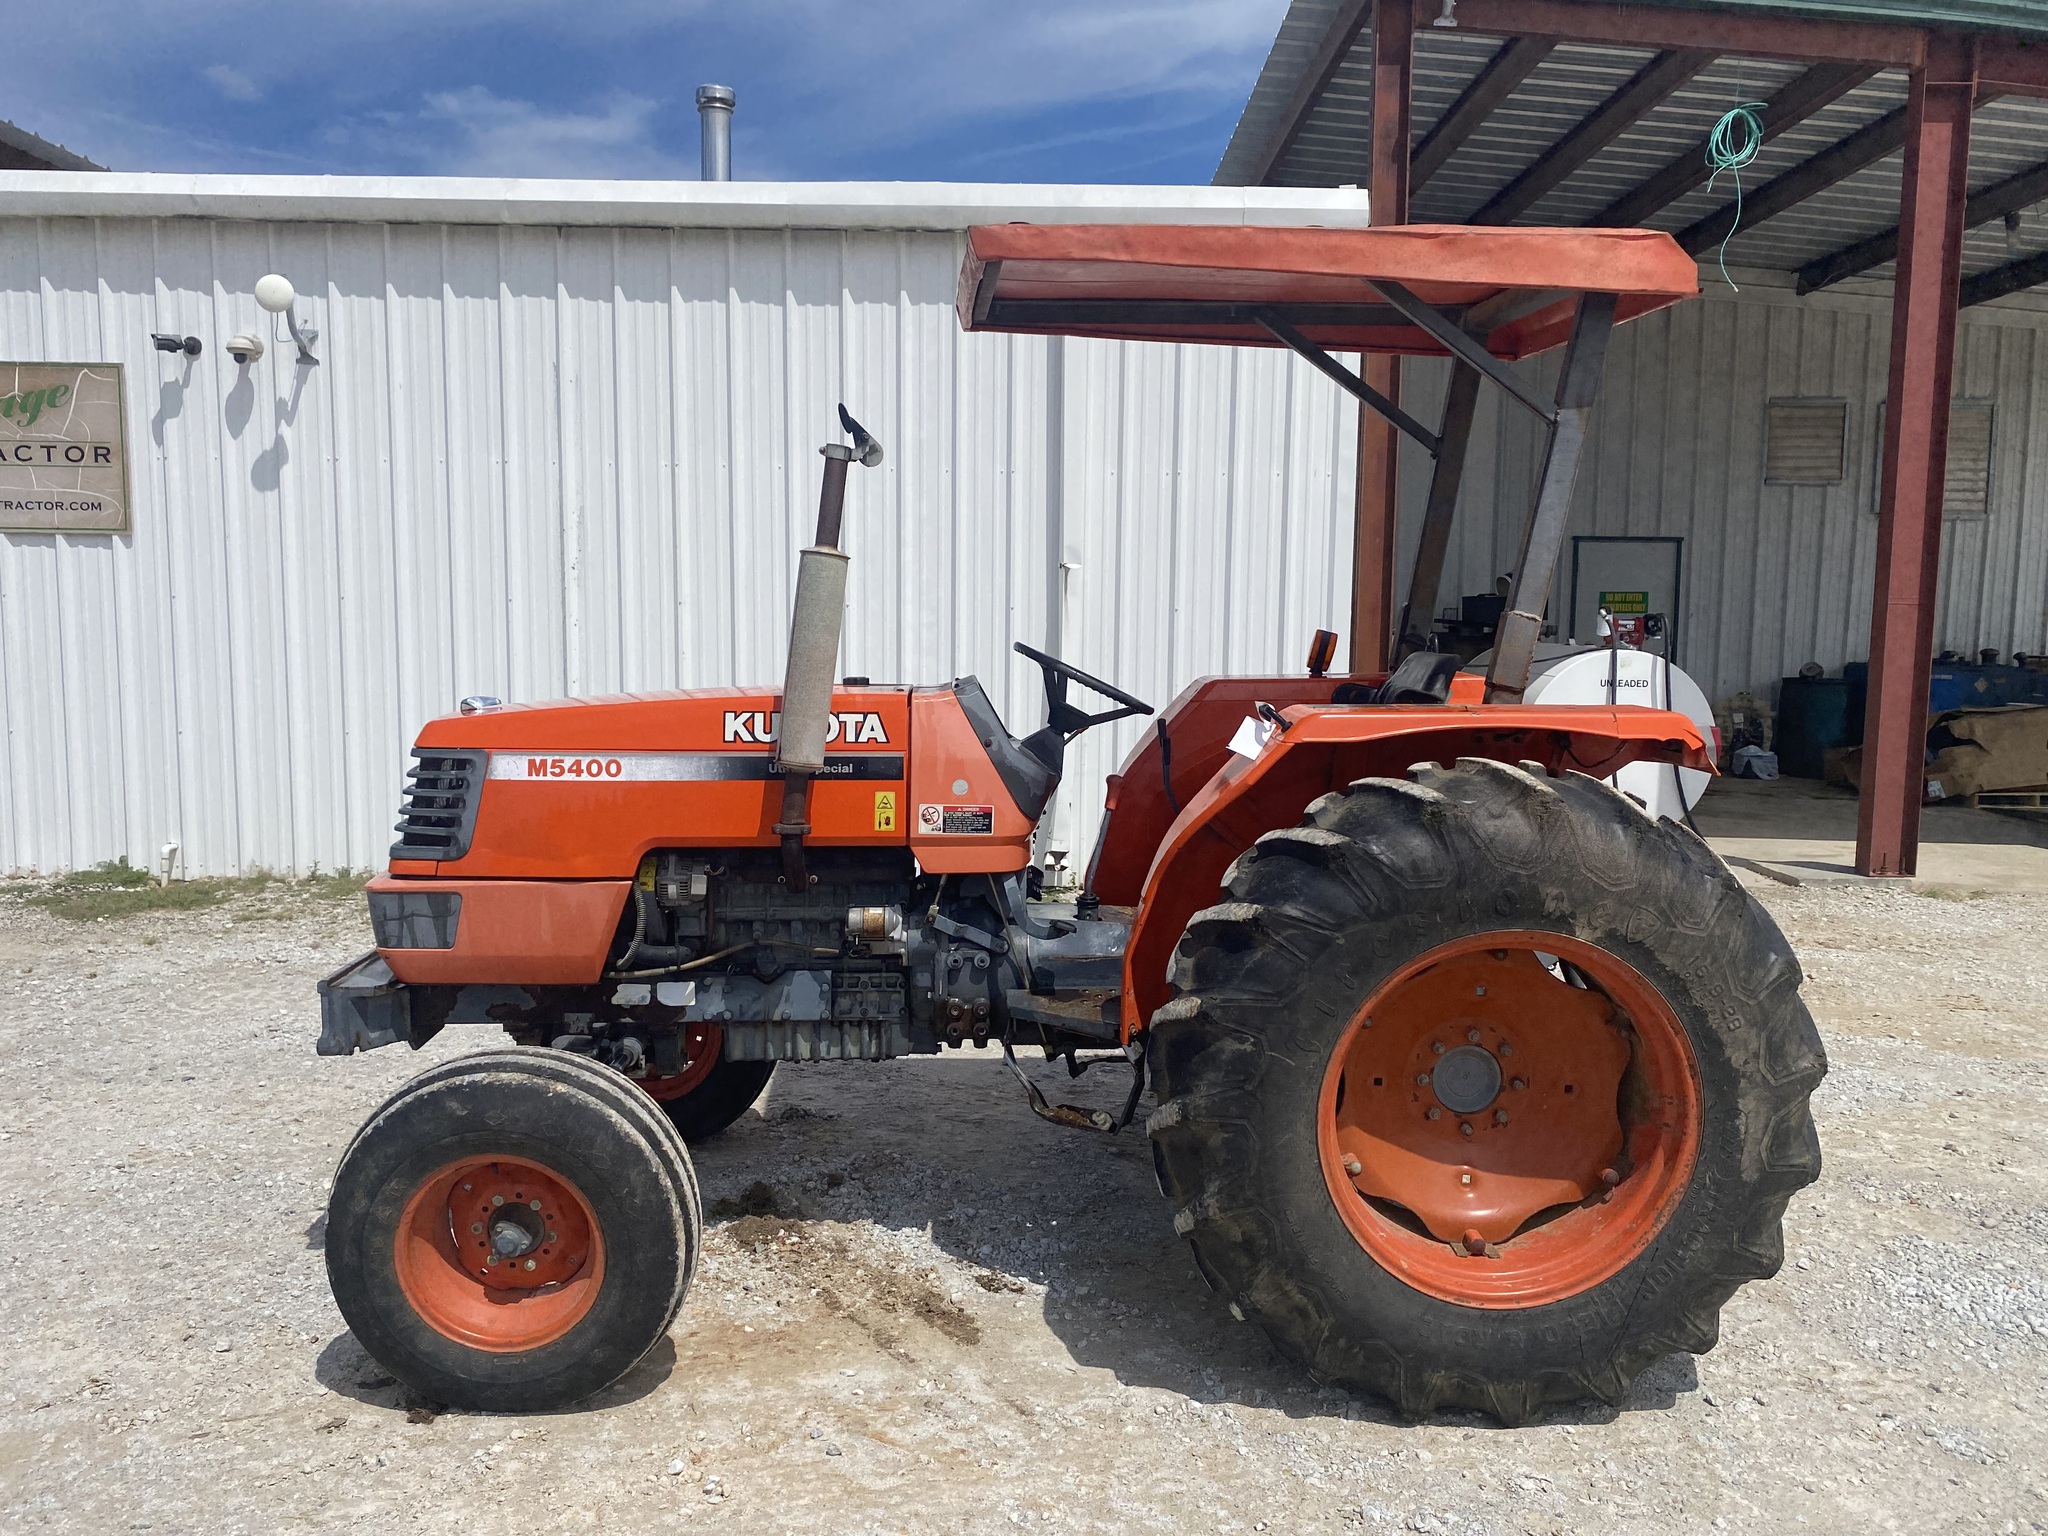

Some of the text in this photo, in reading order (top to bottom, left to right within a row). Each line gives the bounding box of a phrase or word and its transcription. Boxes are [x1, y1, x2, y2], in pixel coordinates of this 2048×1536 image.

[1600, 679, 1649, 688] UNEADED
[723, 711, 890, 744] KUTA
[527, 758, 622, 777] M5400
[815, 763, 853, 776] pecial
